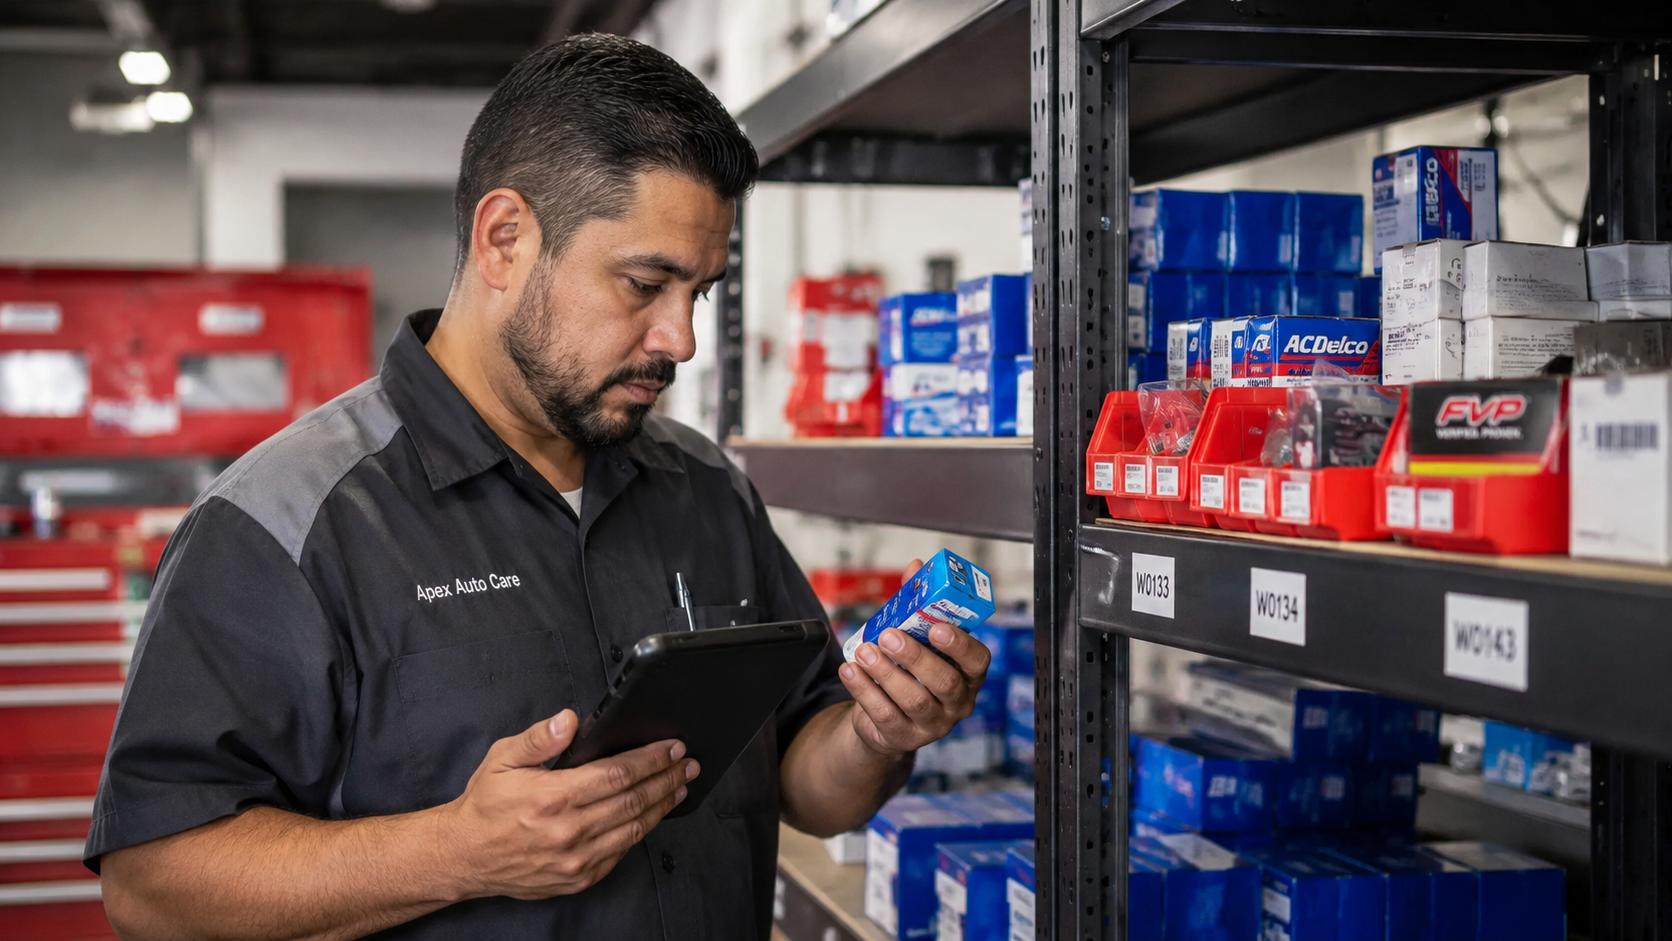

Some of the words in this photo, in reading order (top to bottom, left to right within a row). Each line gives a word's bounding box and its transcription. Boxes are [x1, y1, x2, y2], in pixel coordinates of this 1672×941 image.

[1284, 335, 1368, 354] ACDelco
[1436, 395, 1527, 426] FVP
[417, 585, 452, 602] Apex
[456, 577, 487, 594] Auto
[489, 573, 520, 589] Care
[1137, 572, 1169, 598] W0133
[1256, 590, 1298, 622] W0134
[1454, 621, 1516, 662] W0143
